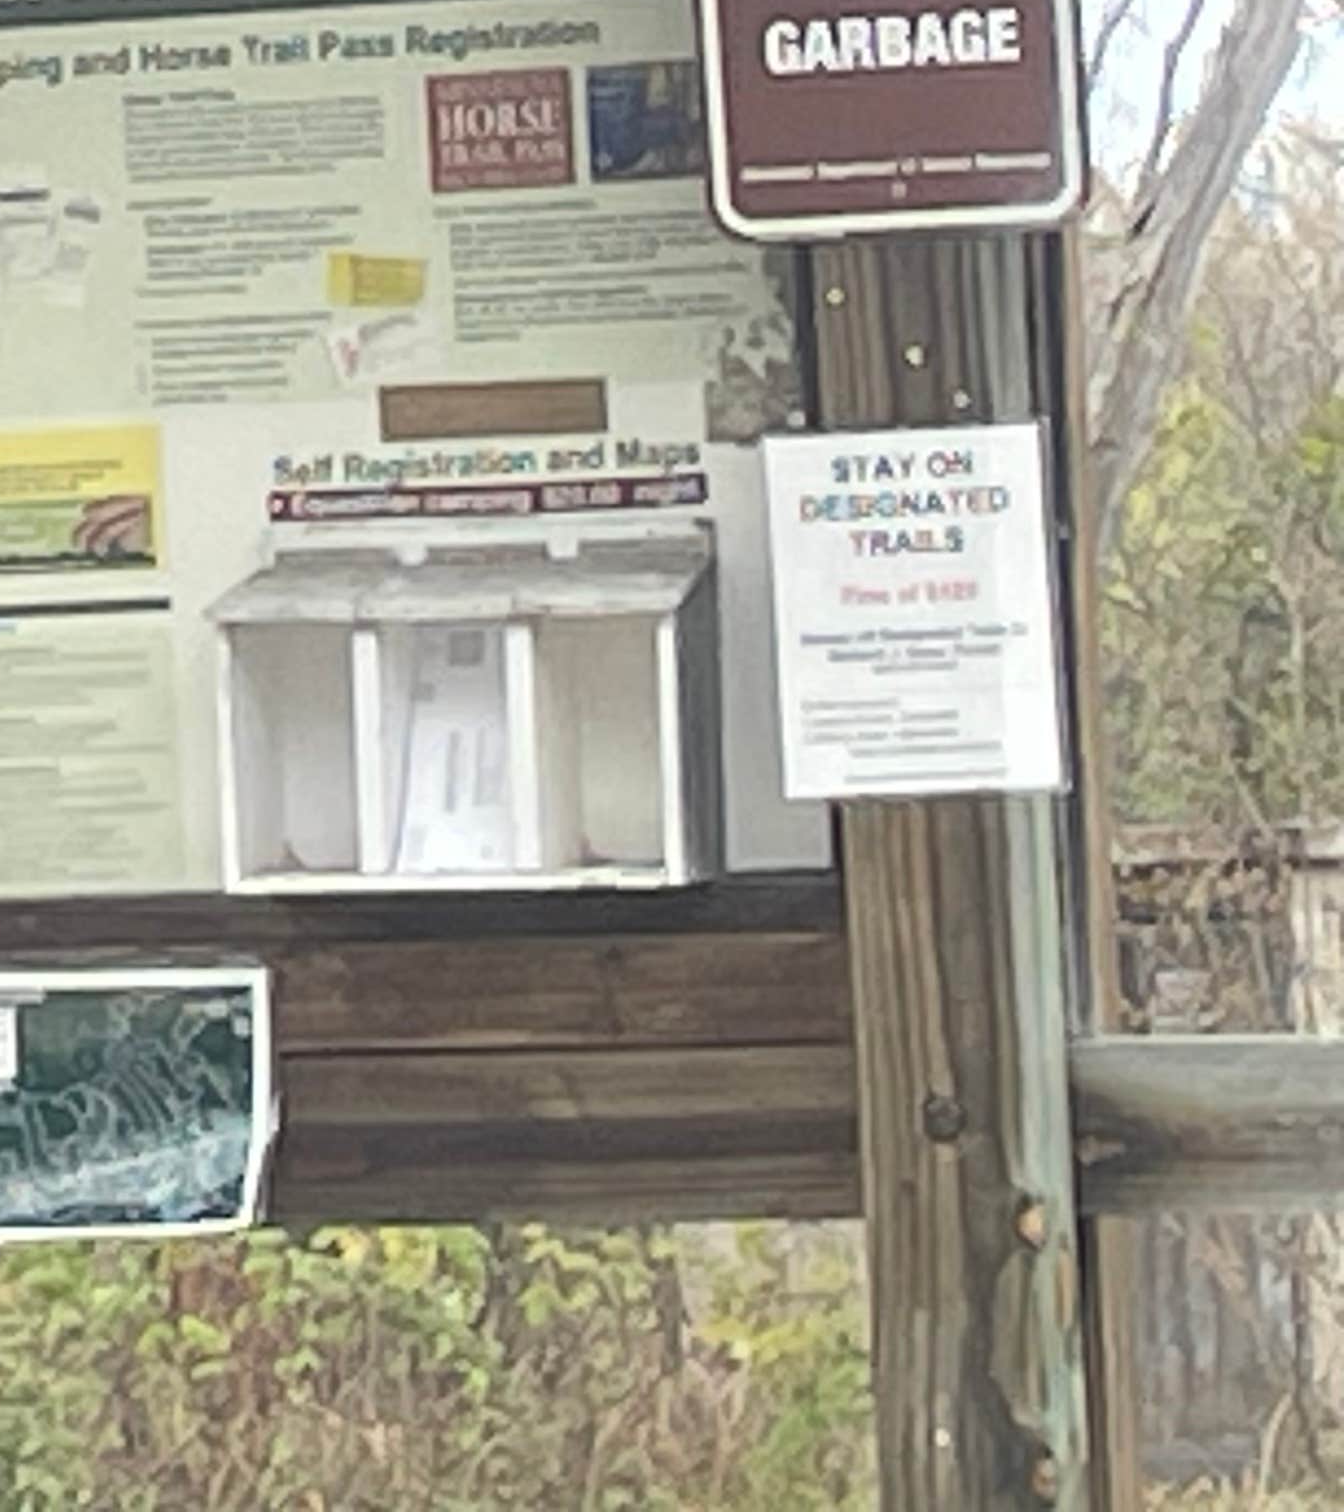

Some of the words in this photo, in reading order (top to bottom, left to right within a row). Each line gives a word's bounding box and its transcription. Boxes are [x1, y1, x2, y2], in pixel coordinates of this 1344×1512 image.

[73, 44, 130, 76] and
[138, 41, 232, 71] Horse
[242, 35, 310, 65] Trail
[319, 31, 395, 61] Pass
[405, 19, 600, 59] Registration
[763, 9, 1021, 76] GARBAGE
[437, 96, 562, 140] HORSE
[273, 454, 332, 486] Self
[342, 446, 538, 486] Registration
[546, 442, 605, 471] and
[615, 439, 701, 475] Maps
[830, 453, 915, 483] STAY
[927, 449, 974, 478] ON
[799, 486, 1010, 522] DESIGNATED
[849, 525, 964, 556] TRAILS
